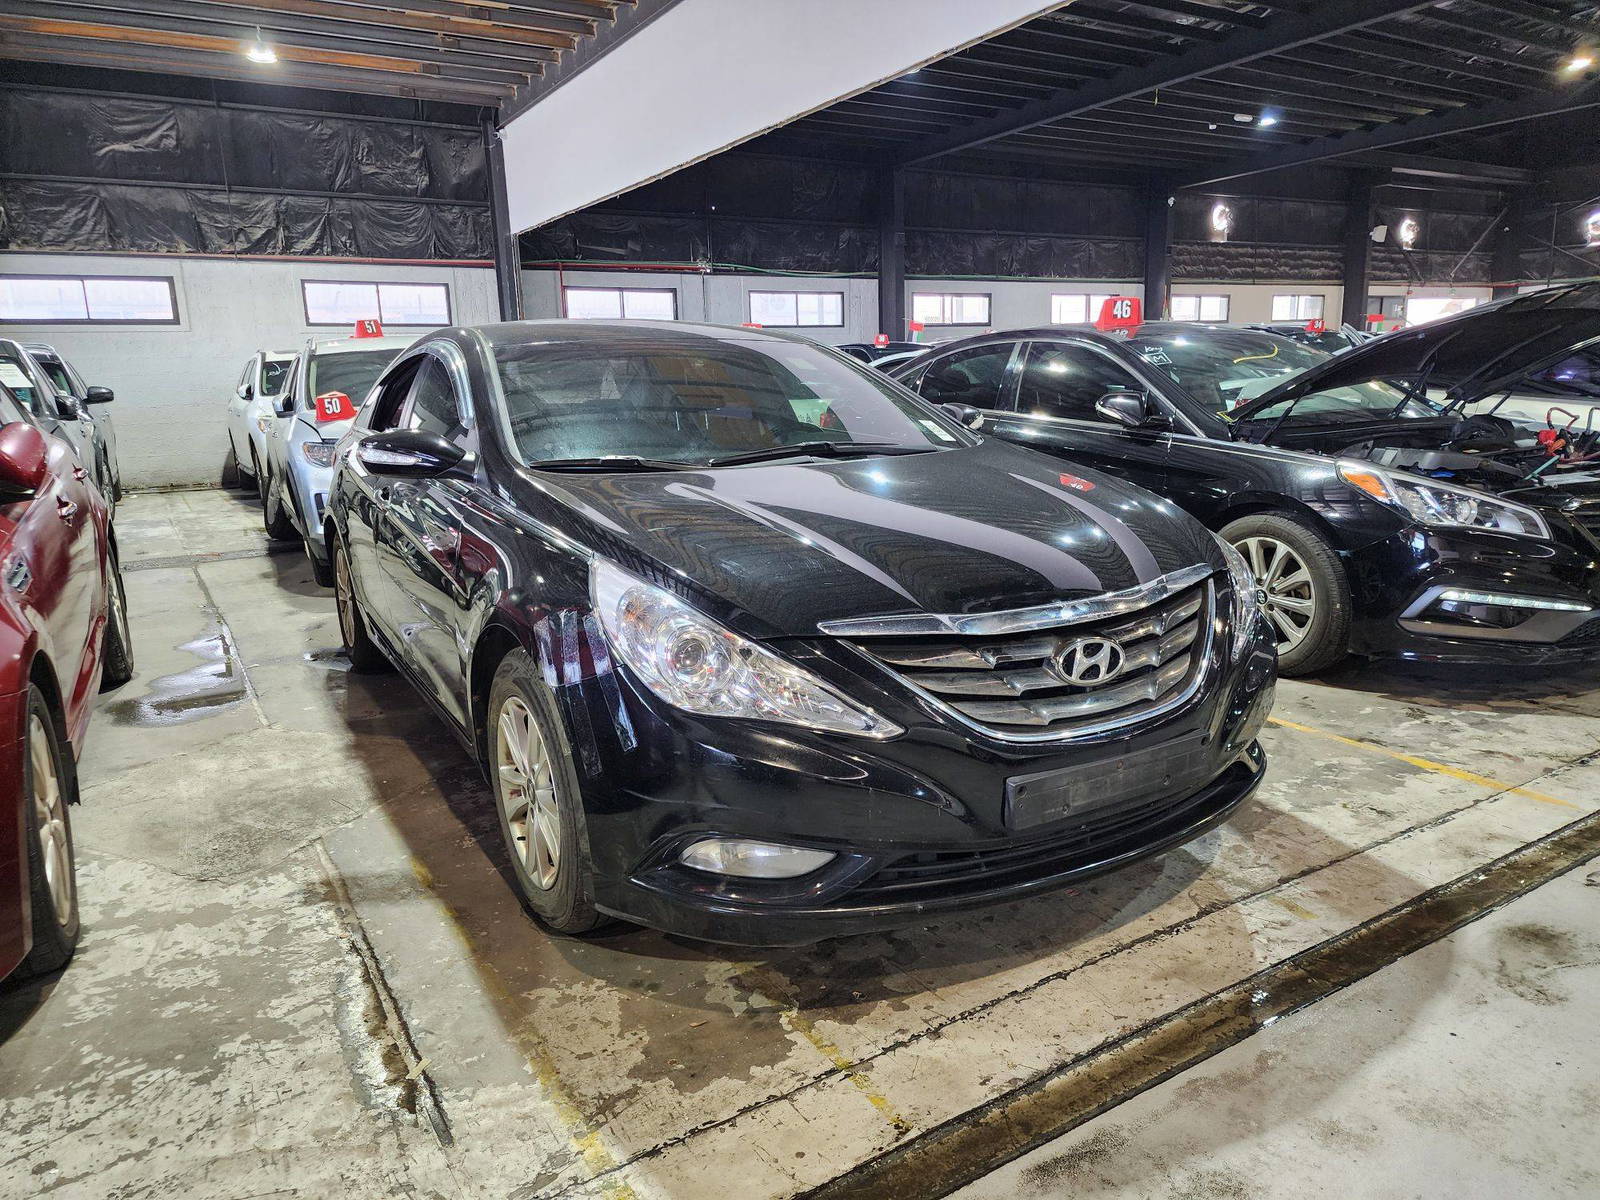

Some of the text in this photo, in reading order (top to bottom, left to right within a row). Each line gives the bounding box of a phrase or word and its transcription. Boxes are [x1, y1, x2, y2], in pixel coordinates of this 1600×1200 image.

[1113, 300, 1131, 319] 46
[364, 320, 377, 334] 51
[324, 397, 341, 415] 50
